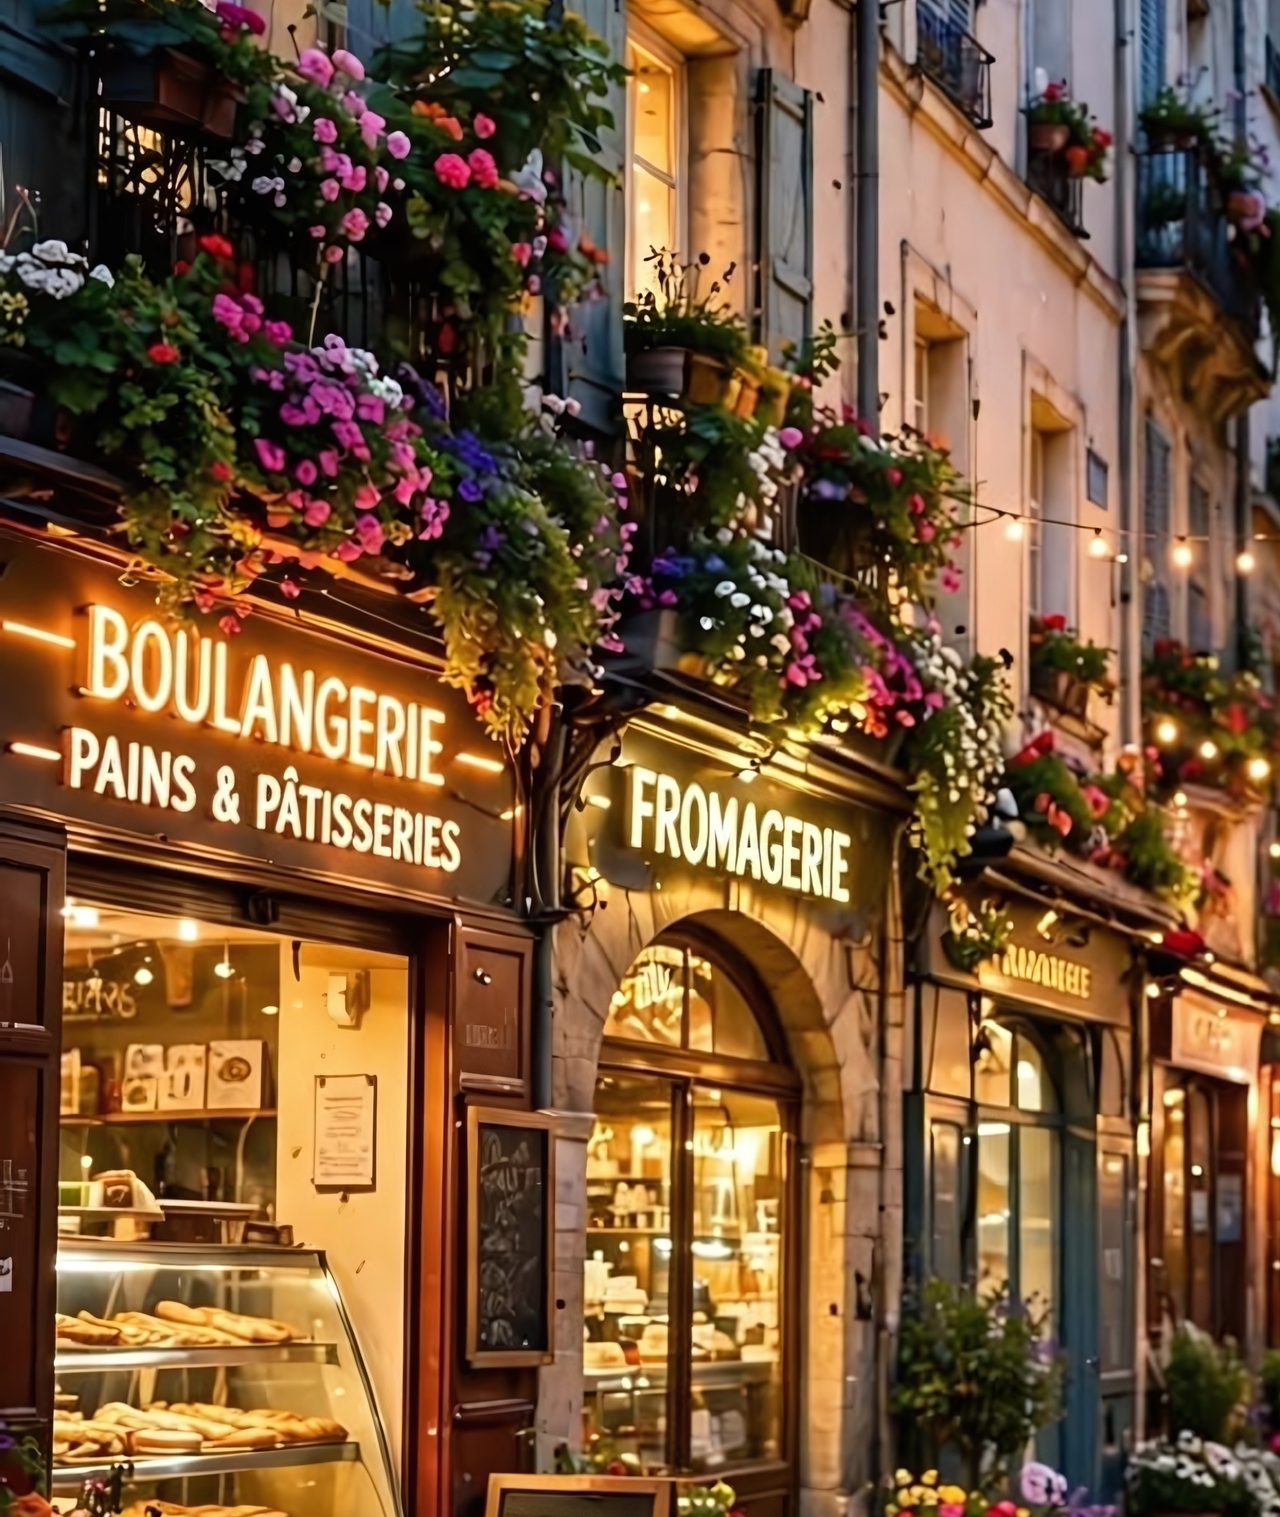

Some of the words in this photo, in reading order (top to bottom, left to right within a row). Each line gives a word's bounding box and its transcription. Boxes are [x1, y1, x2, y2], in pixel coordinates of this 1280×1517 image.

[90, 604, 447, 787] BOULANGERIE
[69, 728, 196, 812] PAINS
[211, 764, 241, 824] &
[256, 767, 461, 873] PÂTISSERIES
[630, 766, 851, 903] FROMAGERIE
